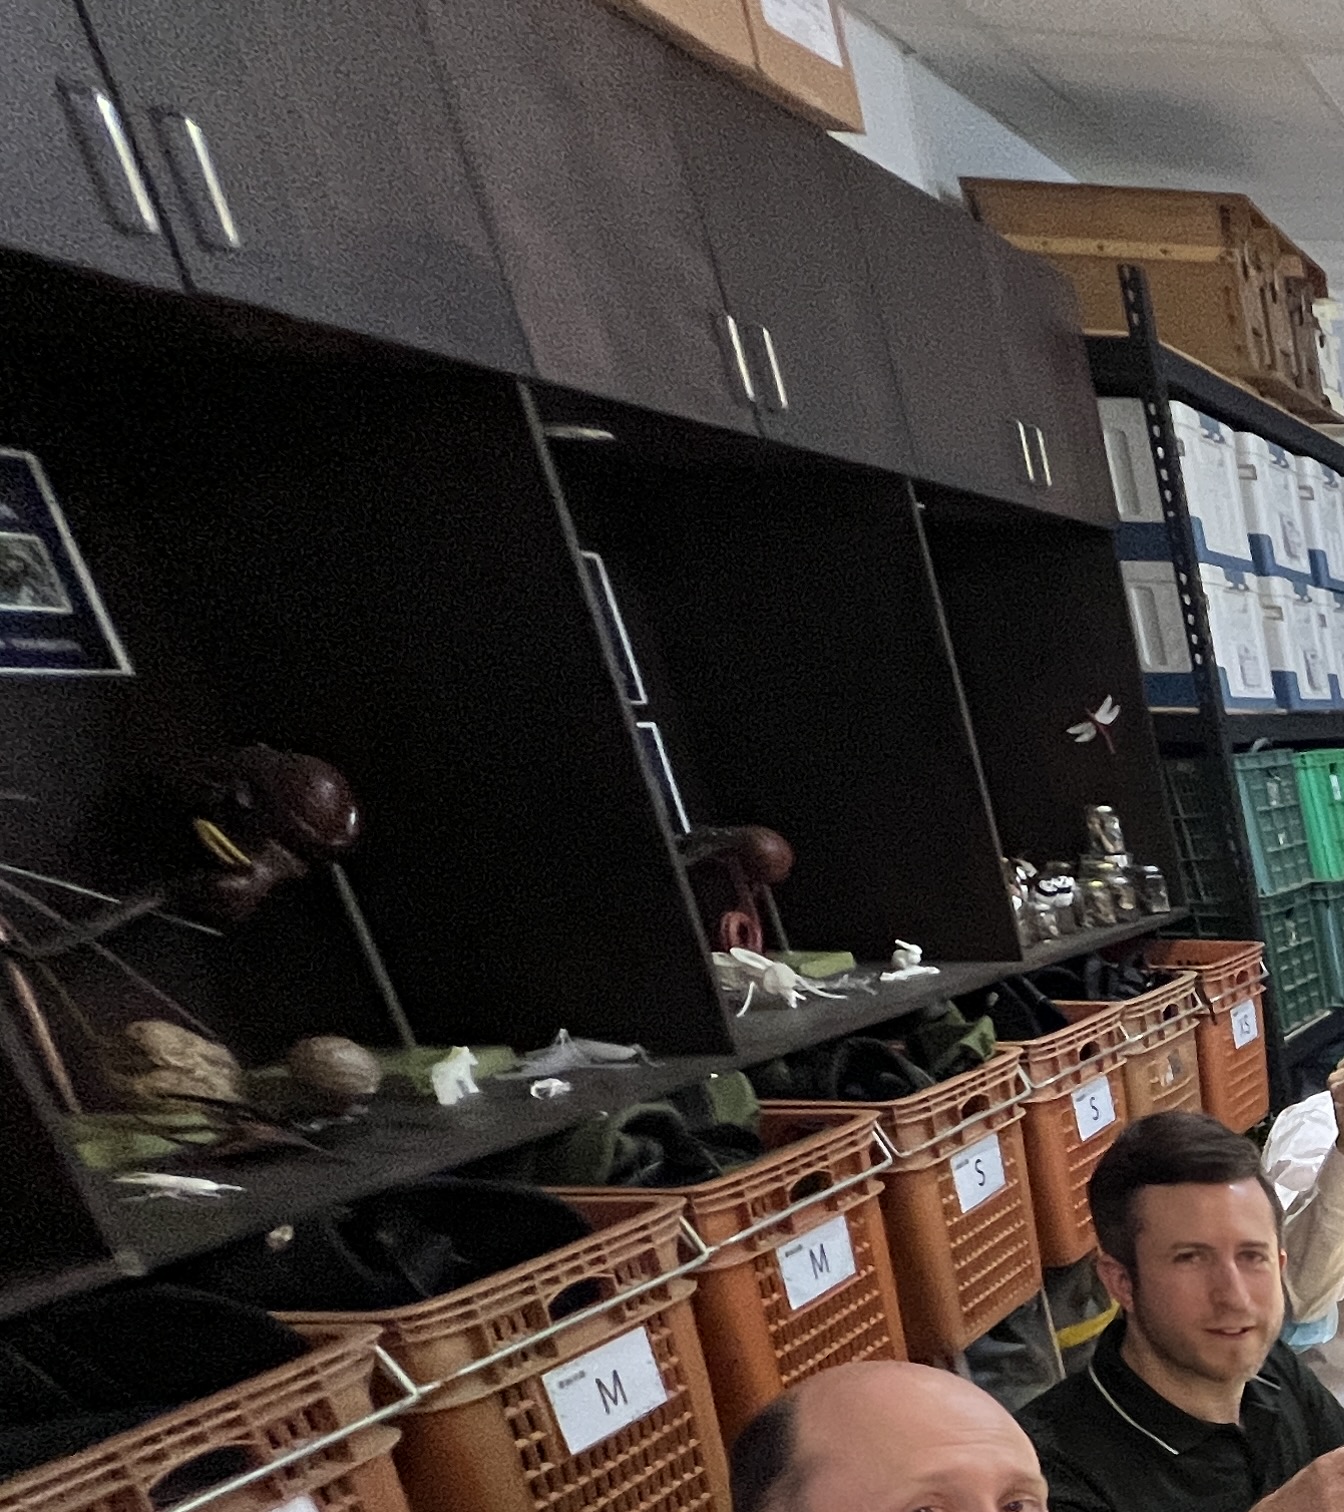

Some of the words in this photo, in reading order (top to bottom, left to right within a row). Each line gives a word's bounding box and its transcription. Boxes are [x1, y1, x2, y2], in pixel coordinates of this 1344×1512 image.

[1089, 1096, 1100, 1121] S
[974, 1158, 986, 1187] S
[808, 1242, 831, 1280] M
[594, 1368, 629, 1416] M
